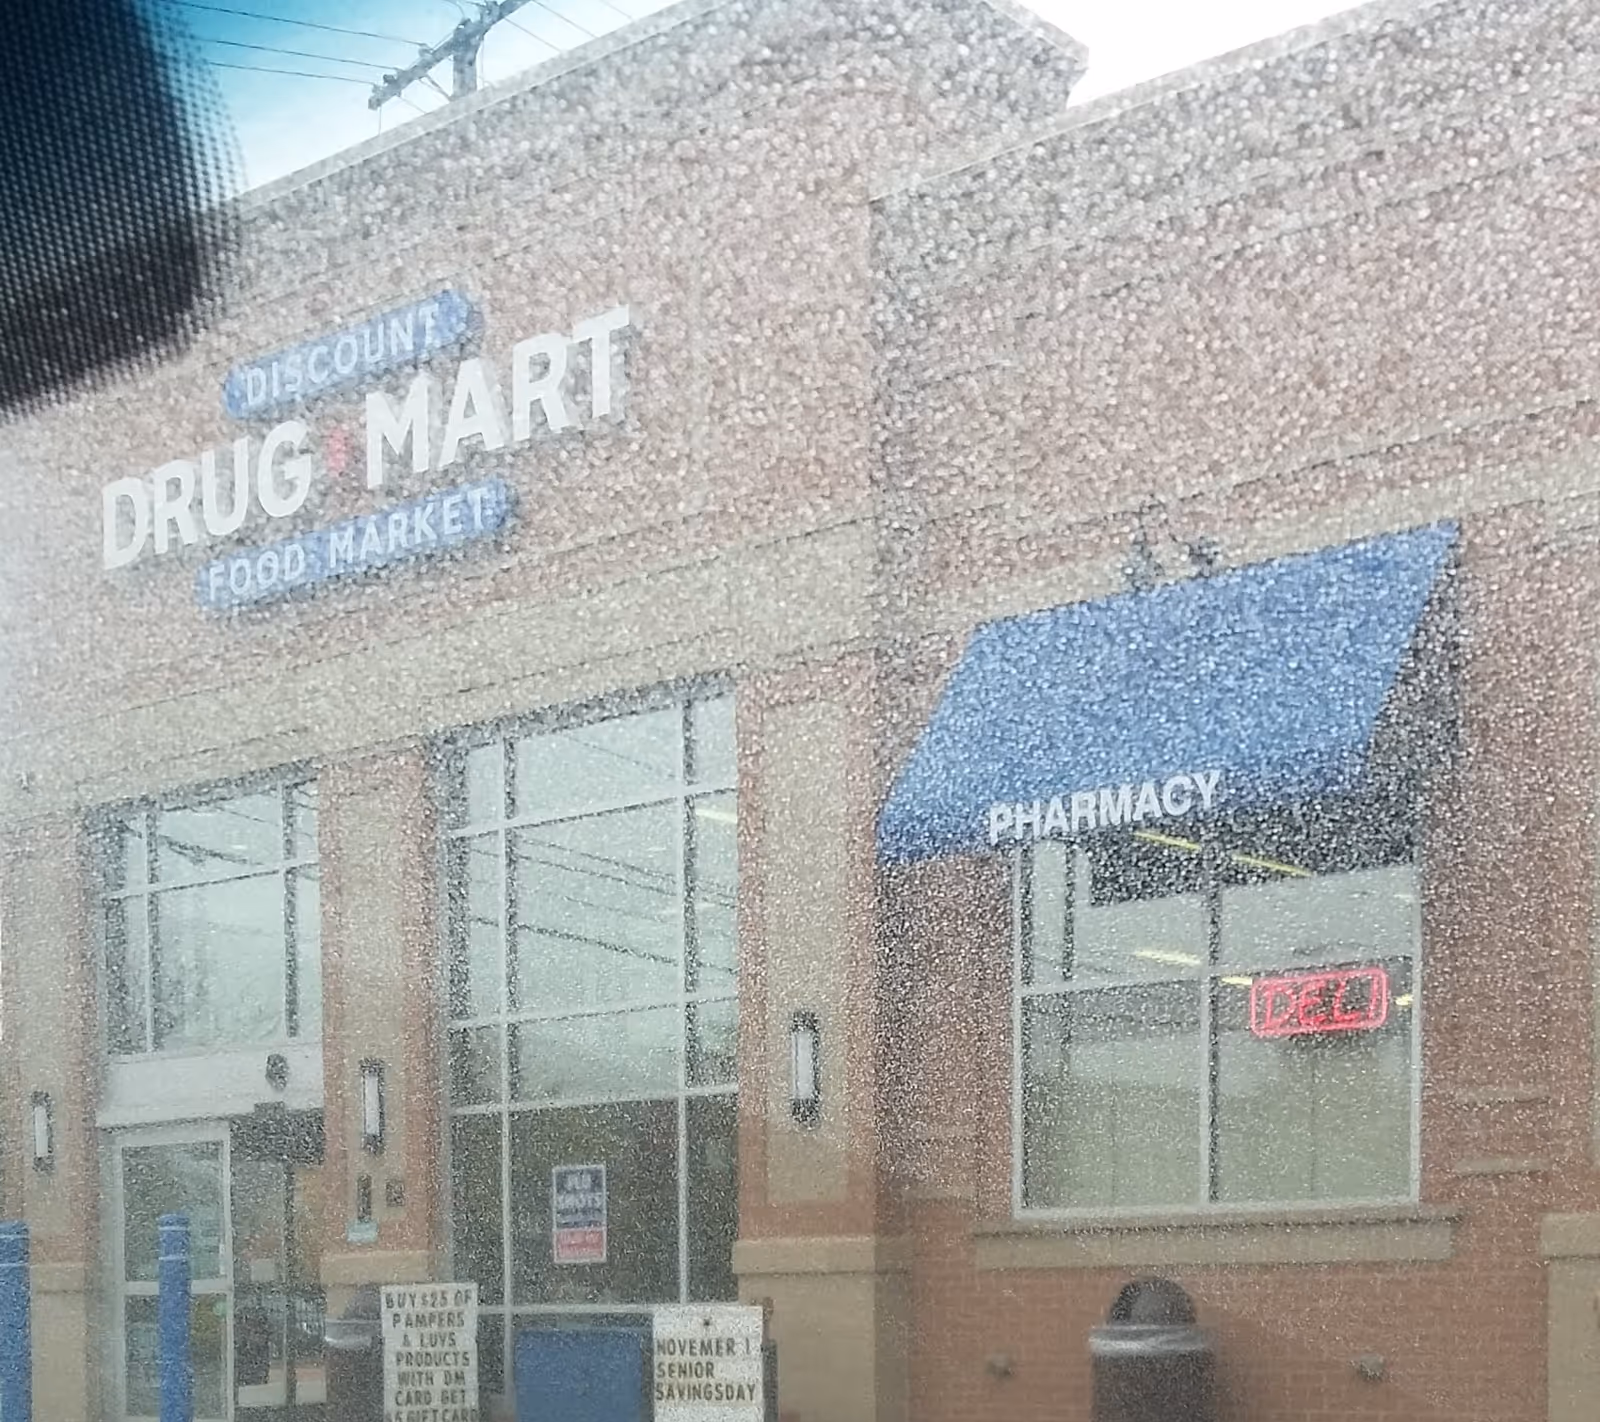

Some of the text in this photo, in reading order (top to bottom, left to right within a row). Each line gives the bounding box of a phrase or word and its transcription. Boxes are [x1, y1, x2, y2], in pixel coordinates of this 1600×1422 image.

[241, 304, 442, 408] DISCOUNT
[102, 304, 630, 571] DRUG MART
[208, 486, 489, 601] FOOD MARKET
[989, 769, 1221, 846] PHARMACY
[1264, 976, 1378, 1028] DELI
[385, 1292, 417, 1309] BUY
[454, 1288, 473, 1306] OF
[392, 1311, 465, 1329] PAMPERS
[420, 1331, 457, 1348] LUVS
[656, 1337, 736, 1358] NOVEMER
[396, 1350, 470, 1367] PRODUCTS
[397, 1370, 434, 1387] WITH
[655, 1361, 715, 1379] SENIOR
[395, 1388, 466, 1407] CARD GET
